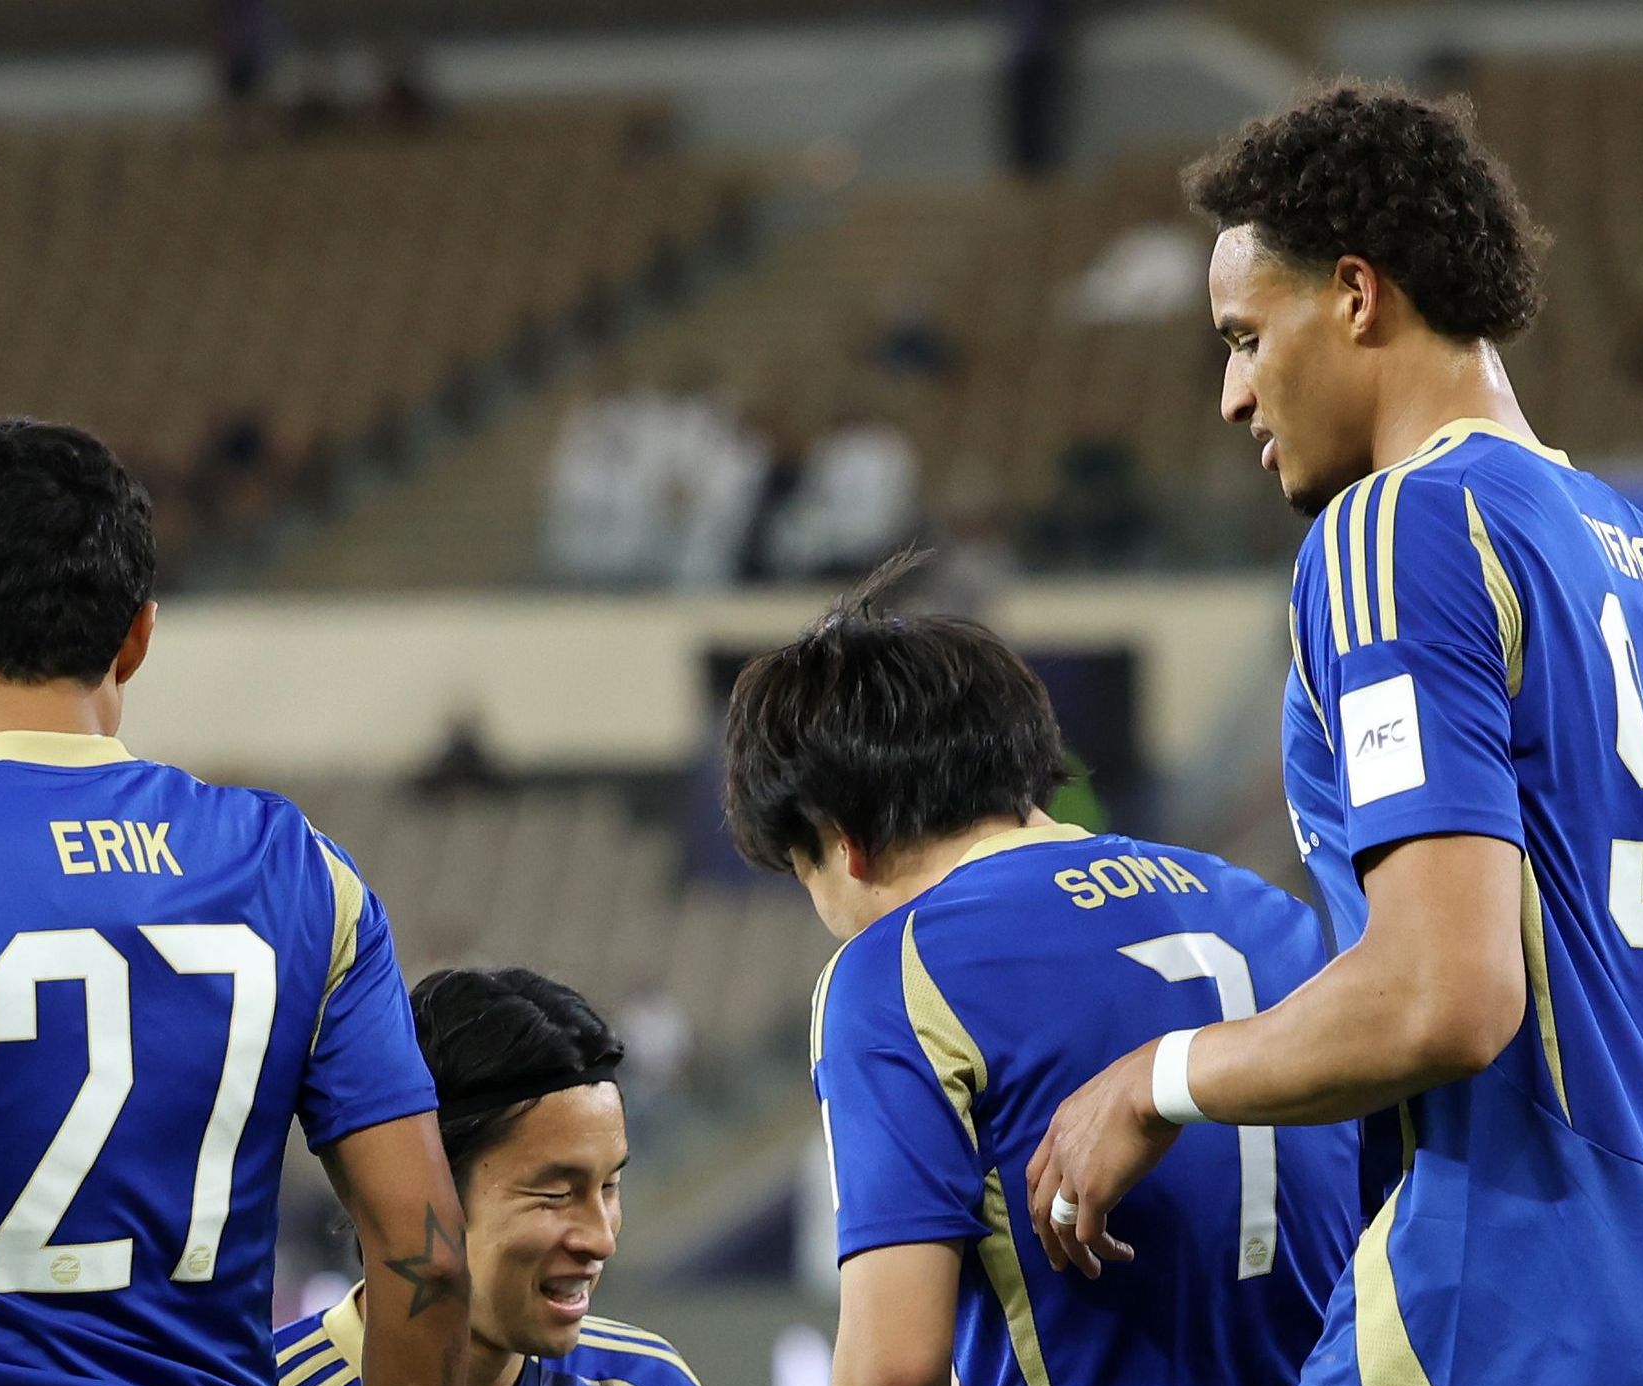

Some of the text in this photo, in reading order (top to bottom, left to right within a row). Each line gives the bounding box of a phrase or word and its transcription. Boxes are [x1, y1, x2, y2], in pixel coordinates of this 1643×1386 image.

[1355, 718, 1405, 757] AFC
[49, 819, 184, 877] ERIK
[1055, 854, 1208, 910] SOMA
[1116, 931, 1277, 1281] 7
